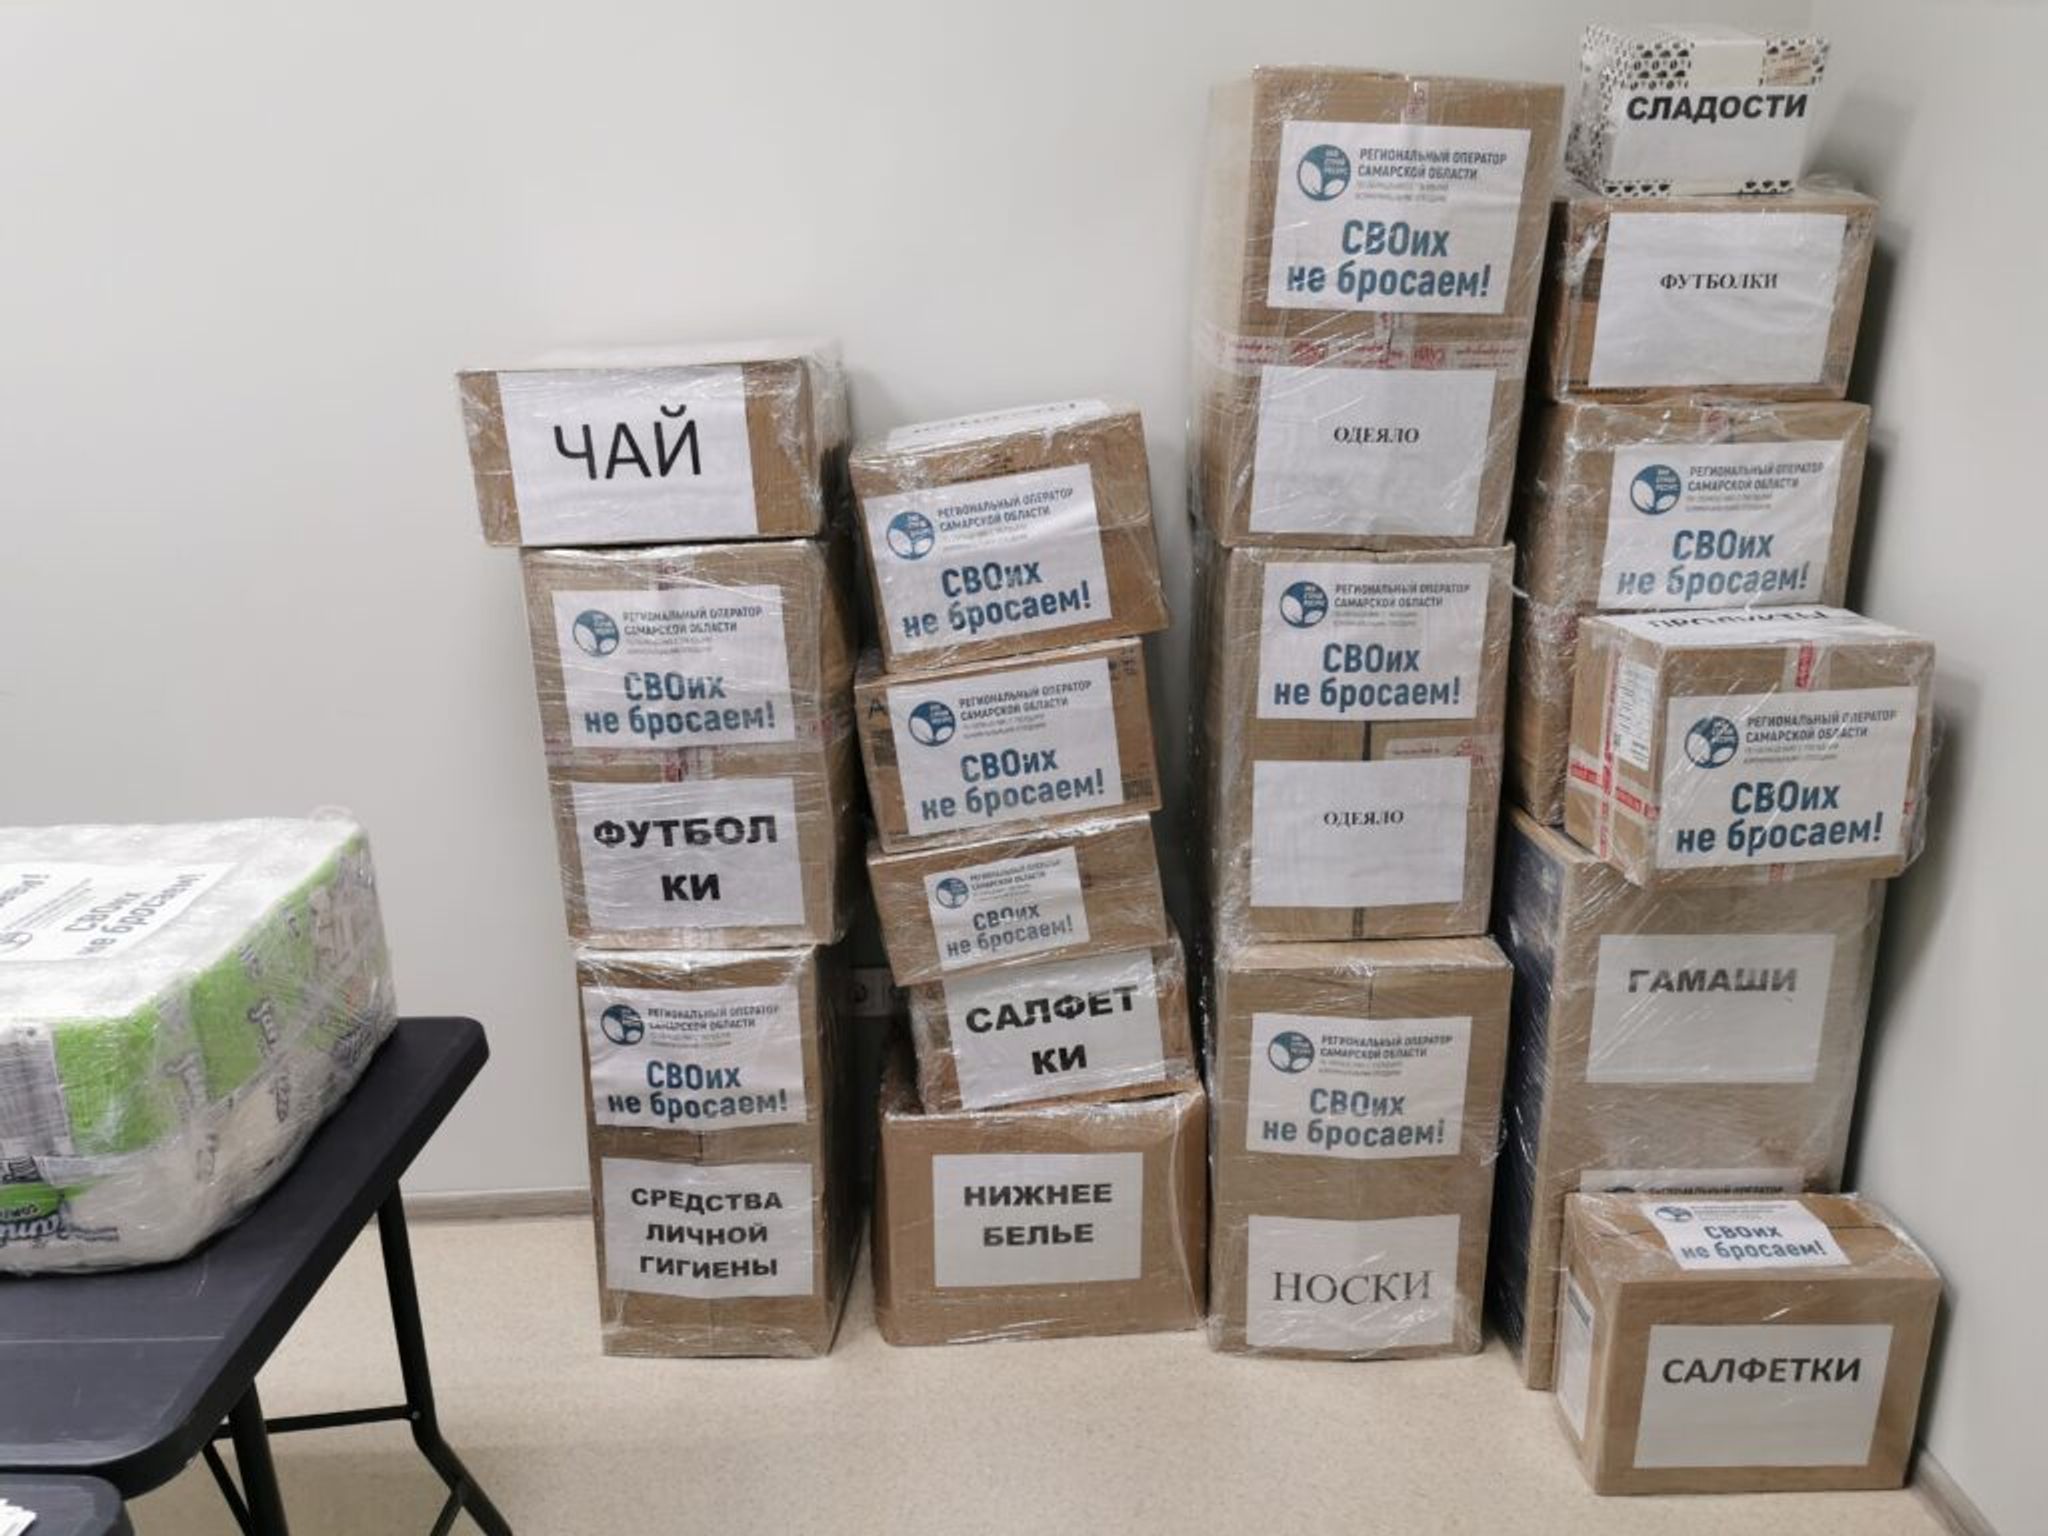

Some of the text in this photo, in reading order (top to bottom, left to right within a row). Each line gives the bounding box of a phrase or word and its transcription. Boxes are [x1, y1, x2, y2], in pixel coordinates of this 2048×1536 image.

[1626, 94, 1808, 124] СЛАДОСТИ
[1359, 147, 1508, 165] РЕГИОНАЛЬНЫЙ ОПЕРАТОР
[1357, 164, 1478, 180] САМАРСКОЙ ОБЛАСТИ
[1341, 219, 1450, 258] СВОих
[1286, 260, 1491, 302] не бросаем!
[1660, 272, 1779, 290] ФУТБОЛКИ
[553, 404, 702, 481] ЧАЙ
[1334, 425, 1419, 444] ОДЕЯЛО
[1690, 463, 1773, 476] РЕГИОНАЛЬНЫЙ
[1688, 478, 1752, 492] САМАРСКОЙ
[937, 494, 1021, 519] РЕГИОНАЛЬНЫЙ
[939, 506, 1051, 532] САМАРСКОЙ ОБЛАСТИ
[1672, 529, 1775, 561] СВОих
[941, 561, 1043, 599] СВОих
[1335, 583, 1417, 594] РЕГИОНАЛЬНЫЙ
[1616, 562, 1811, 602] не бросаем!
[902, 580, 1091, 638] не бросаем!
[1334, 597, 1396, 608] САМАРСКОЙ
[1322, 642, 1420, 674] СВОих
[623, 671, 727, 701] СВОих
[958, 680, 1092, 708] РЕГИОНАЛЬНЫЙ ОПЕРАТОР
[1273, 676, 1460, 713] не бросаем!
[584, 700, 776, 740] не бросаем!
[960, 701, 1022, 721] САМАРСКОЙ
[1747, 710, 1839, 727] РЕГИОНАЛЬНЫЙ
[1746, 727, 1815, 743] САМАРСКОЙ
[960, 748, 1059, 784] СВОих
[921, 798, 956, 821] не
[965, 768, 1104, 818] бросаем!
[1731, 779, 1840, 815] СВОих
[593, 814, 777, 848] ФУТБОЛ
[1324, 809, 1404, 828] ОДЕЯЛО
[1675, 811, 1883, 856] не бросаем!
[661, 873, 720, 901] КИ
[973, 904, 1040, 931] СВОих
[946, 913, 1073, 957] не бросаем!
[1628, 967, 1798, 993] ГАМАШИ
[965, 984, 1138, 1033] САЛФЕТ
[1031, 1044, 1087, 1075] КИ
[646, 1060, 742, 1090] СВОих
[608, 1088, 788, 1123] не бросаем!
[1310, 1088, 1406, 1117] СВОих
[1263, 1118, 1445, 1150] не бросаем!
[631, 1187, 783, 1215] СРЕДСТВА
[963, 1183, 1112, 1207] НИЖНЕЕ
[646, 1222, 768, 1246] ЛИЧНОЙ
[983, 1223, 1094, 1247] БЕЛЬЕ
[1703, 1225, 1783, 1240] СВОих
[1681, 1239, 1827, 1261] не бросаем!
[639, 1255, 777, 1279] ГИГИЕНЫ
[1272, 1270, 1435, 1305] НОСКИ
[1662, 1356, 1861, 1385] САЛФЕТКИ
